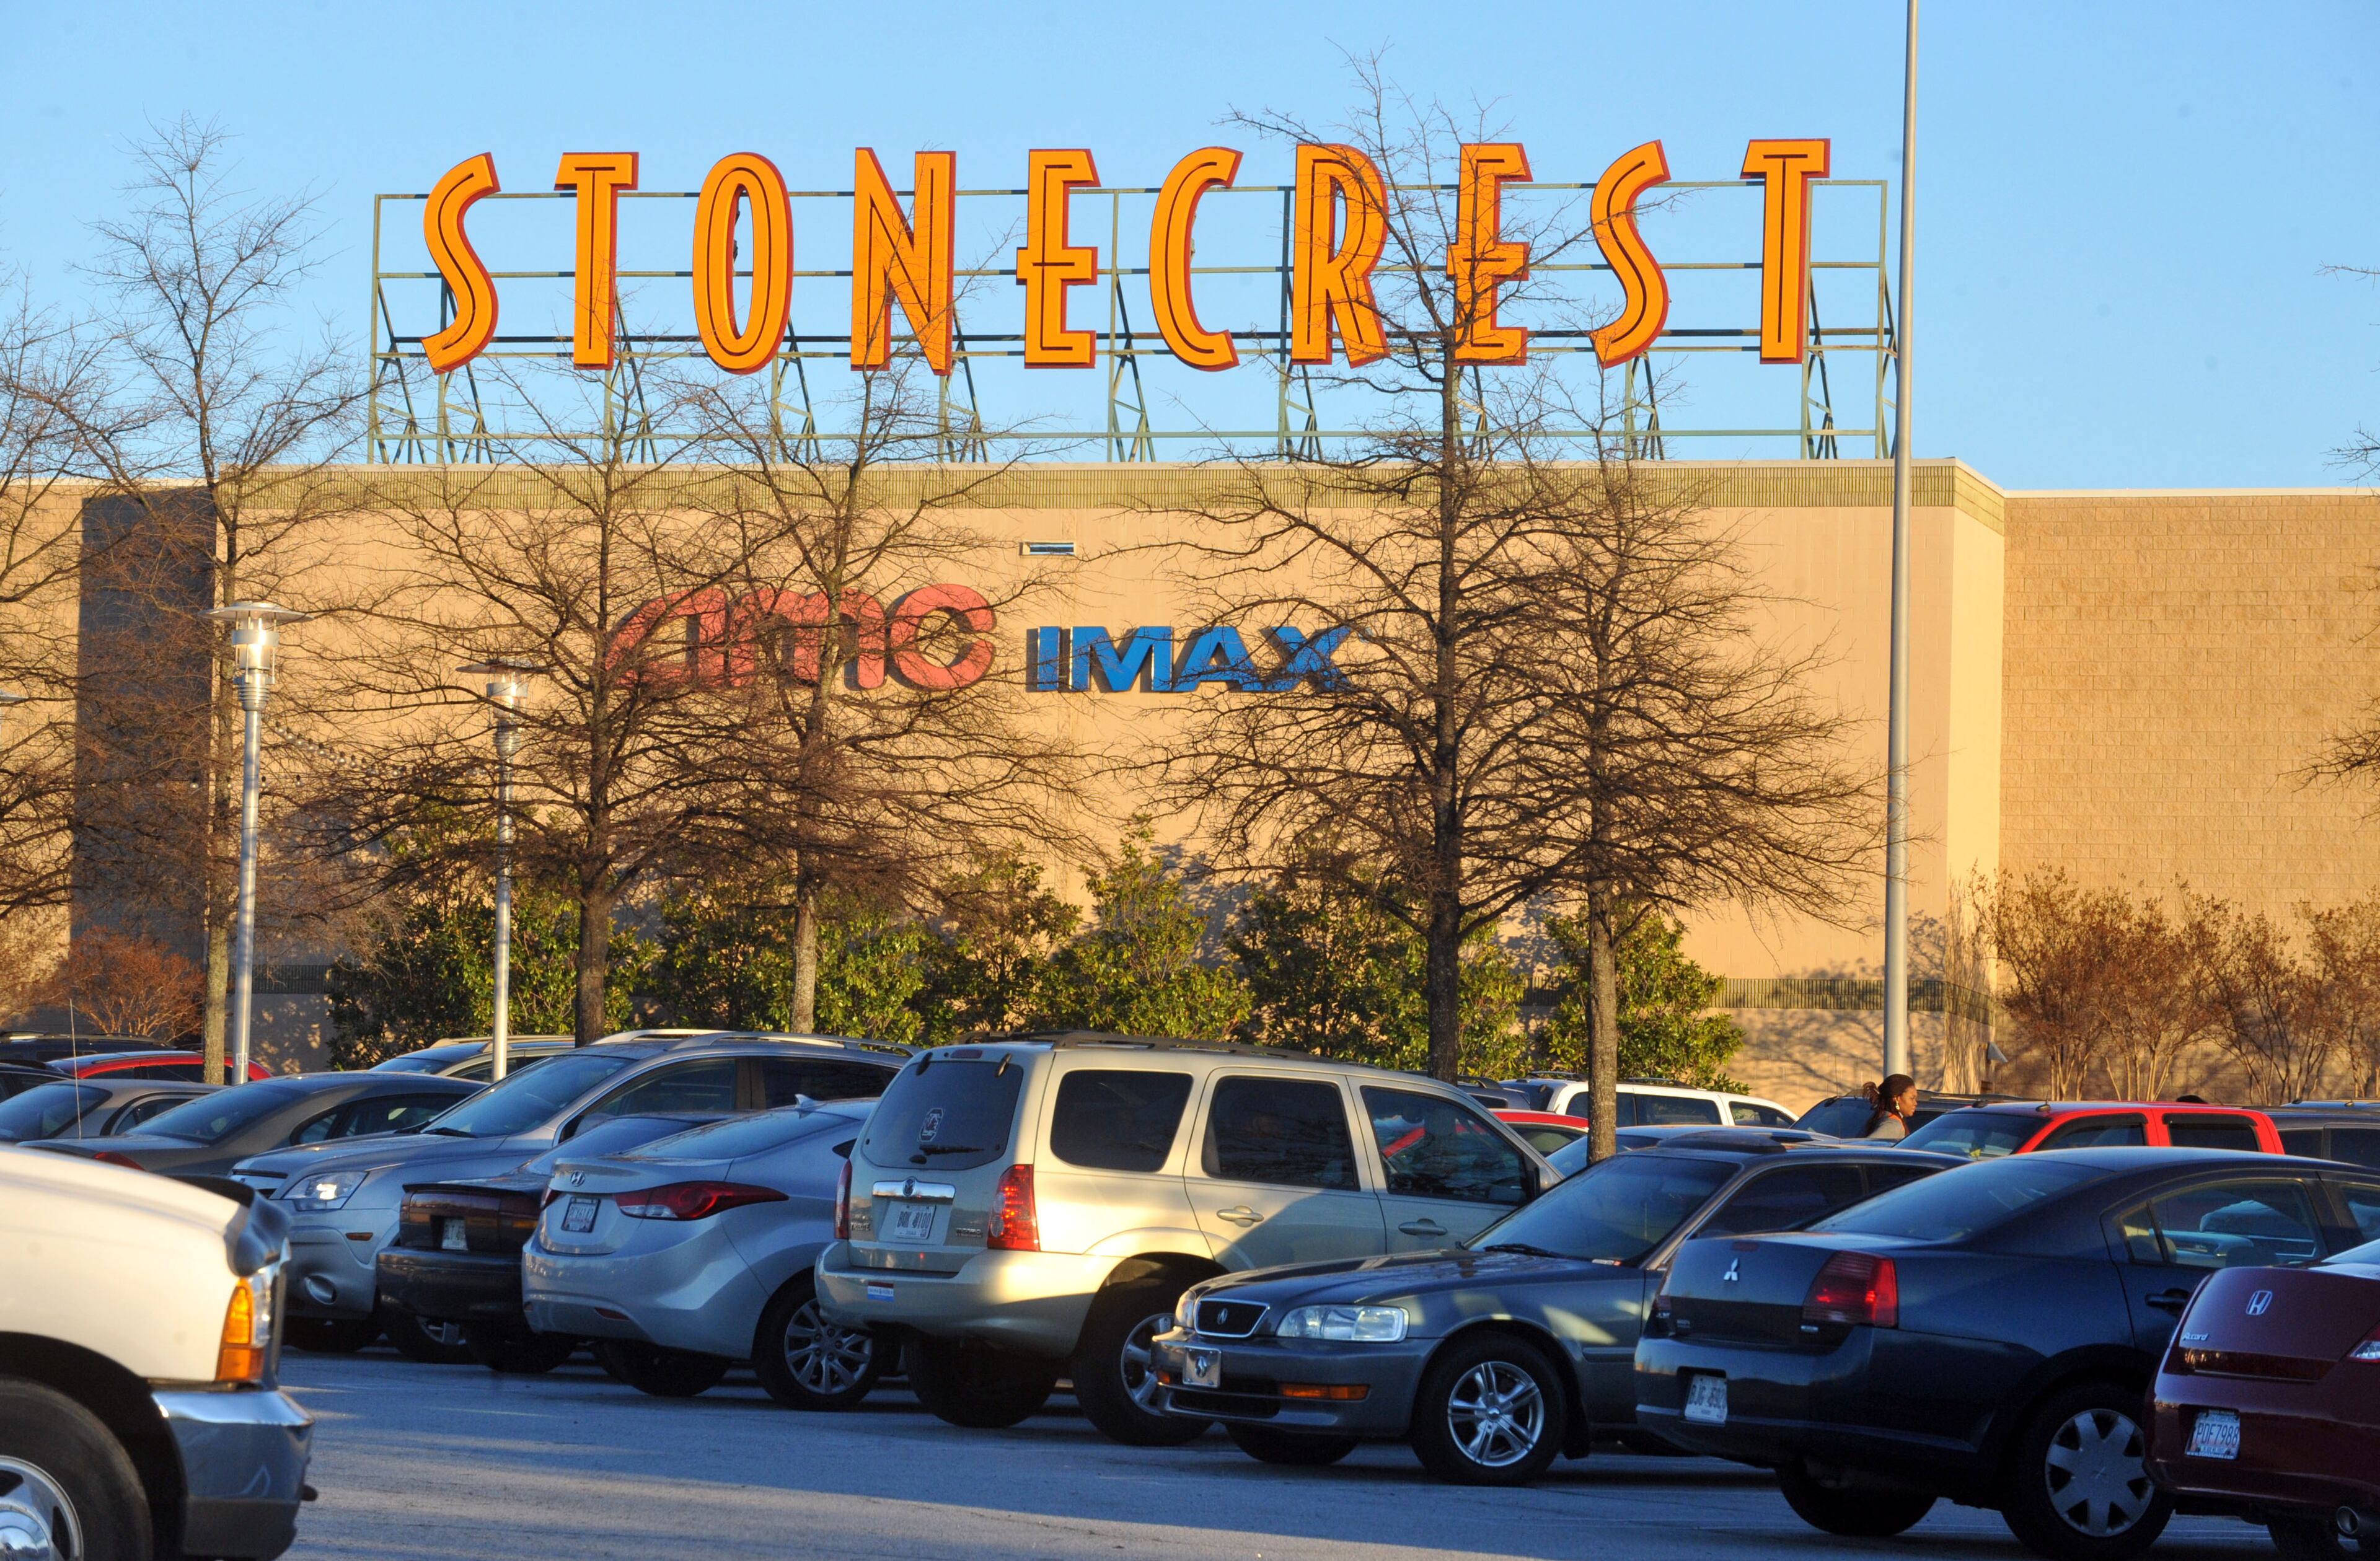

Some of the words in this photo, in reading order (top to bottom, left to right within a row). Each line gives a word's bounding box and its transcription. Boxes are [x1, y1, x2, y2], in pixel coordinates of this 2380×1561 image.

[419, 138, 1830, 375] STONECREST
[1026, 626, 1352, 693] IMAX
[2182, 1332, 2209, 1341] Accord
[2195, 1422, 2239, 1446] PDF7988
